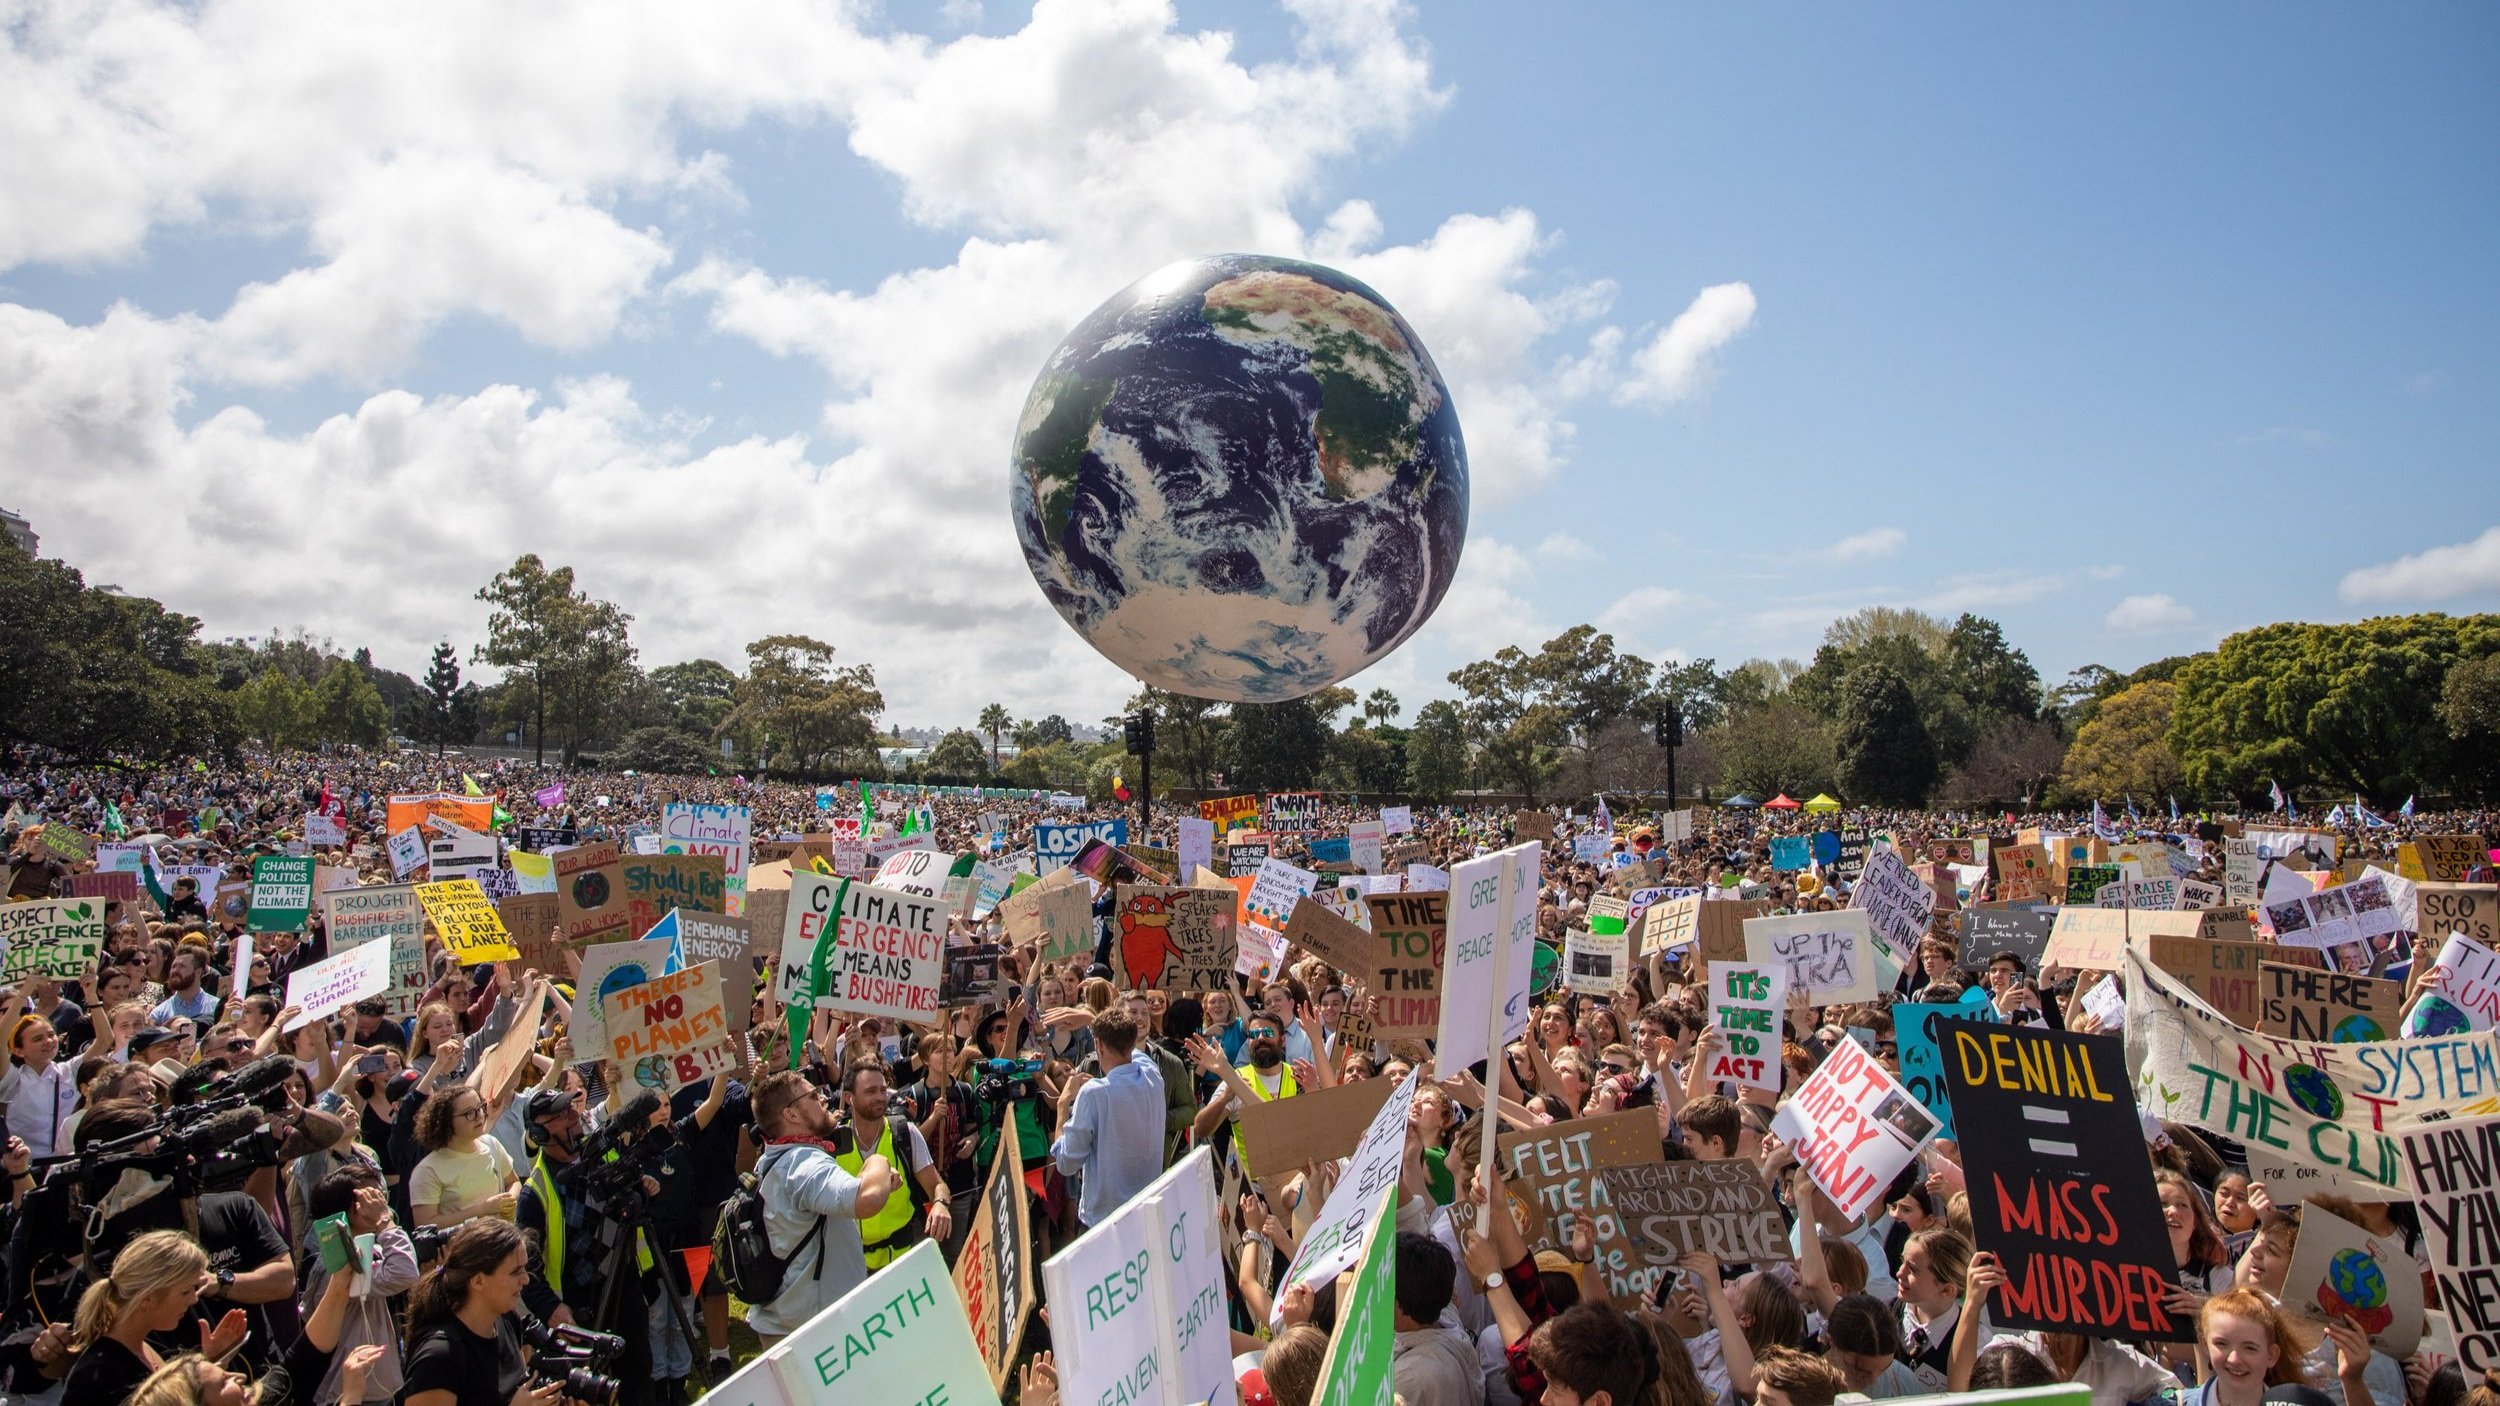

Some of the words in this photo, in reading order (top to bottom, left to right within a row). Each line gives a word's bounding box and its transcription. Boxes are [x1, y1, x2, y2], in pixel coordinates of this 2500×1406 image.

[1268, 794, 1275, 812] I
[1275, 793, 1319, 813] WANT
[431, 818, 458, 834] ACTION
[668, 814, 742, 843] Climate
[1841, 826, 1865, 842] And
[874, 843, 897, 853] GLOBAL
[1232, 846, 1247, 856] WE
[1247, 846, 1265, 856] ARE
[1841, 842, 1864, 856] saw
[2227, 842, 2256, 856] HELL
[2426, 838, 2444, 851] IF
[2448, 837, 2481, 851] YOU
[557, 856, 578, 871] OUR
[586, 847, 616, 866] EARTH
[905, 851, 931, 877] TO
[1999, 850, 2023, 861] THERE
[2024, 849, 2034, 859] IS
[2431, 851, 2472, 862] NEED
[2473, 850, 2487, 862] A
[262, 861, 308, 872] CHANGE
[1274, 865, 1292, 880] SURE
[1294, 876, 1308, 886] THE
[1838, 860, 1862, 871] was
[2036, 867, 2045, 879] B
[2070, 868, 2083, 881] I
[2088, 868, 2114, 881] BET
[258, 872, 308, 883] POLITICS
[623, 863, 696, 900] Study
[1260, 874, 1298, 893] DINOSAURS
[1863, 860, 1902, 900] LEADER
[1873, 849, 1893, 867] WE
[1892, 860, 1921, 892] NEED
[1922, 890, 1932, 907] A
[2227, 872, 2254, 884] COAL
[258, 886, 283, 896] NOT
[285, 885, 306, 896] THE
[417, 885, 445, 896] THE
[449, 883, 475, 896] ONLY
[1190, 889, 1208, 902] THE
[1250, 892, 1263, 903] HAD
[1741, 889, 1761, 900] NOT
[2133, 880, 2174, 896] RAISE
[2183, 884, 2215, 904] WAKE
[2229, 885, 2253, 894] MINE
[257, 897, 305, 908] CLIMATE
[334, 892, 414, 912] DROUGHT
[423, 895, 446, 905] ONE
[446, 892, 485, 903] WARMING
[428, 904, 447, 917] UP
[446, 902, 465, 914] TO
[465, 900, 490, 911] YOUR
[2130, 893, 2177, 908] VOICES
[2423, 893, 2476, 919] SCO
[0, 905, 58, 934] ESPECT
[335, 910, 406, 926] BUSHFIRES
[434, 908, 495, 925] POLICIES
[510, 905, 535, 922] THE
[1179, 901, 1219, 918] SPEAKS
[1372, 898, 1446, 928] TIME
[1853, 882, 1895, 938] CLIMATE
[334, 923, 391, 941] BARRIER
[390, 921, 423, 936] REEF
[446, 923, 461, 934] IS
[466, 922, 498, 934] OUR
[569, 918, 593, 934] OUR
[598, 911, 627, 927] HOME
[1195, 917, 1209, 928] THE
[2204, 925, 2217, 936] IS
[449, 932, 509, 950] PLANET
[1177, 927, 1213, 946] TREES
[1378, 930, 1430, 959] TO
[1773, 933, 1811, 957] UP
[1816, 931, 1853, 951] The
[2420, 935, 2440, 950] an
[4, 943, 79, 971] XPECT
[684, 937, 743, 962] ENERGY?
[1456, 932, 1494, 967] PEACE
[2211, 943, 2265, 971] EARTH
[842, 951, 912, 980] MEANS
[1190, 954, 1213, 966] TREES
[1216, 953, 1233, 968] SAY
[333, 966, 355, 979] DIE
[404, 972, 427, 988] NO
[1379, 968, 1434, 992] THE
[303, 967, 369, 1002] CLIMATE
[615, 966, 705, 1012] THERE'S
[848, 972, 938, 1012] BUSHFIRES
[2209, 975, 2257, 1014] NOT
[2263, 965, 2373, 1012] THERE
[307, 982, 361, 1011] CHANGE
[643, 993, 684, 1027] NO
[2262, 998, 2287, 1023] IS
[612, 1003, 726, 1061] PLANET
[1342, 1015, 1351, 1029] I
[1726, 1033, 1761, 1056] TO
[1713, 1056, 1765, 1082] ACT
[1822, 1039, 1891, 1105] NOT
[1954, 1030, 2115, 1103] DENIAL
[2355, 1039, 2500, 1102] SYSTEM
[1797, 1071, 1880, 1155] HAPPY
[2188, 1062, 2292, 1150] THE
[1512, 1131, 1594, 1178] FELT
[1603, 1165, 1689, 1191] MIGHT
[1691, 1161, 1752, 1187] MESS
[1797, 1127, 1878, 1213] JAN!
[2263, 1167, 2287, 1180] FOR
[2296, 1167, 2321, 1179] OUR
[1616, 1185, 1711, 1214] AROUND
[1710, 1185, 1765, 1212] AND
[1992, 1170, 2120, 1247] MASS
[1639, 1210, 1790, 1267] STRIKE
[1991, 1249, 2174, 1333] MURDER
[813, 1276, 936, 1388] EARTH
